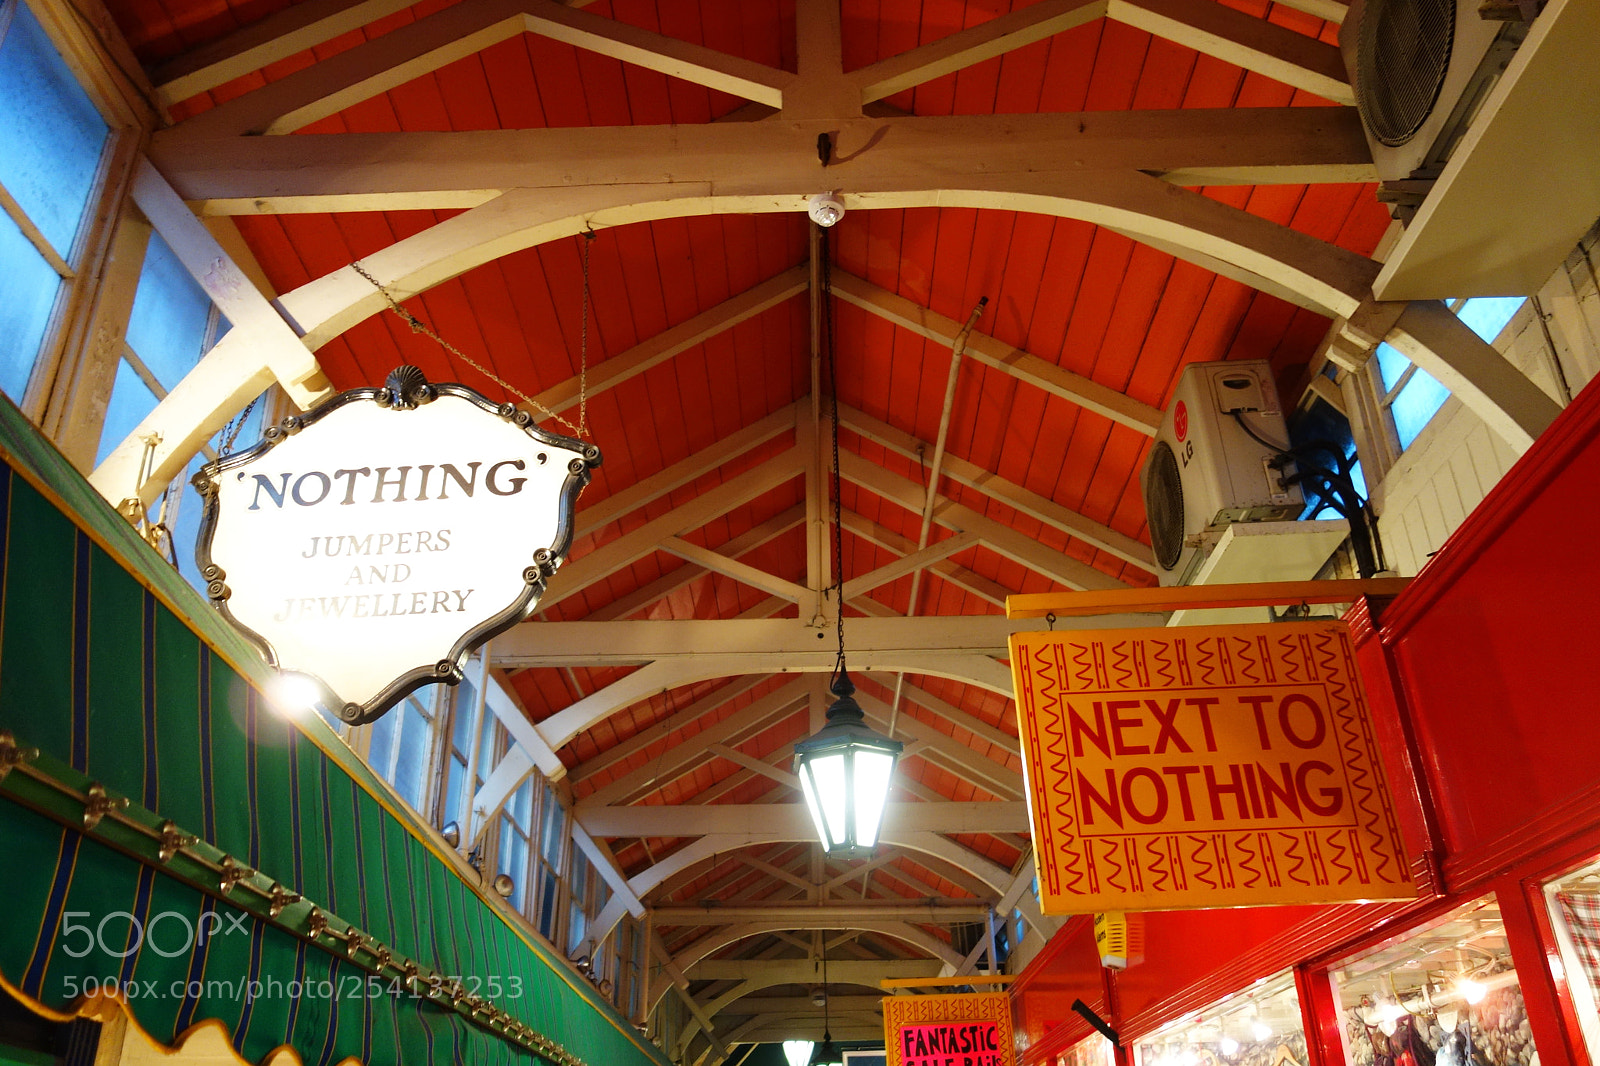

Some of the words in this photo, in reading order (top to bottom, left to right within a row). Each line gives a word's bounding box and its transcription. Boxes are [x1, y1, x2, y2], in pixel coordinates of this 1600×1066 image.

[1181, 440, 1193, 468] LG
[301, 529, 452, 559] JUMPERS
[344, 563, 411, 585] AND
[274, 589, 475, 622] JEWELLERY
[1067, 697, 1219, 760] NEXT
[1238, 693, 1327, 751] TO
[1076, 760, 1343, 829] NOTHING
